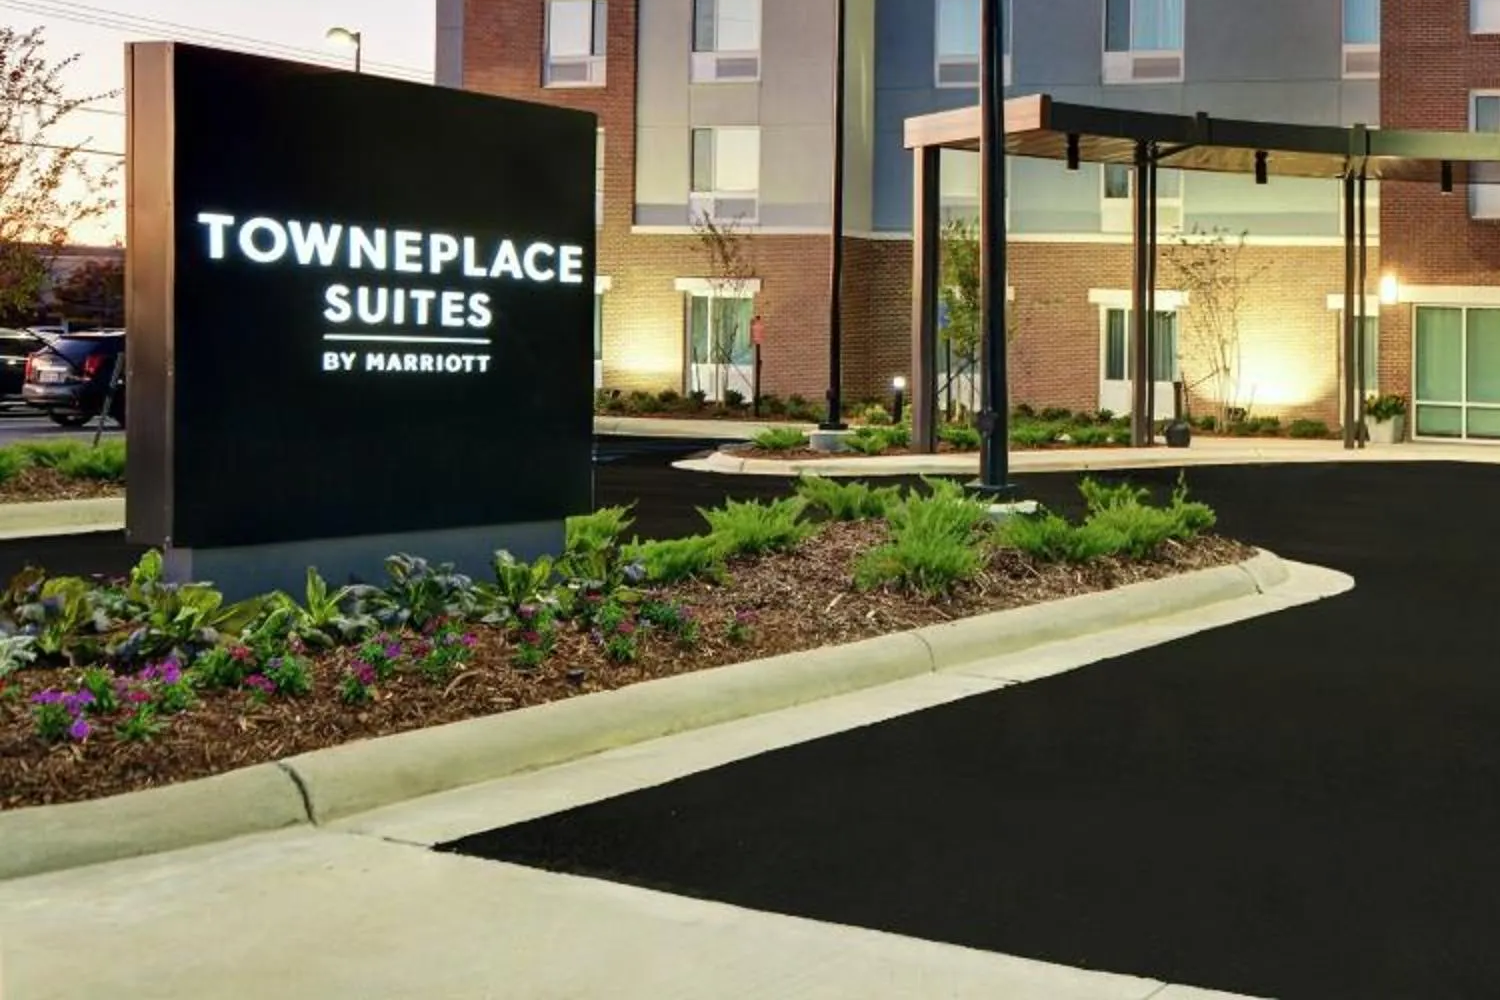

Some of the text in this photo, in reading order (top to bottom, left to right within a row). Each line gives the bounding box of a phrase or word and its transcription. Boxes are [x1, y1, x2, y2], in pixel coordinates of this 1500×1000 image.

[197, 212, 584, 283] TOWNEPLACE
[323, 283, 493, 327] SUITES
[322, 352, 491, 372] BY MARRIOTT
